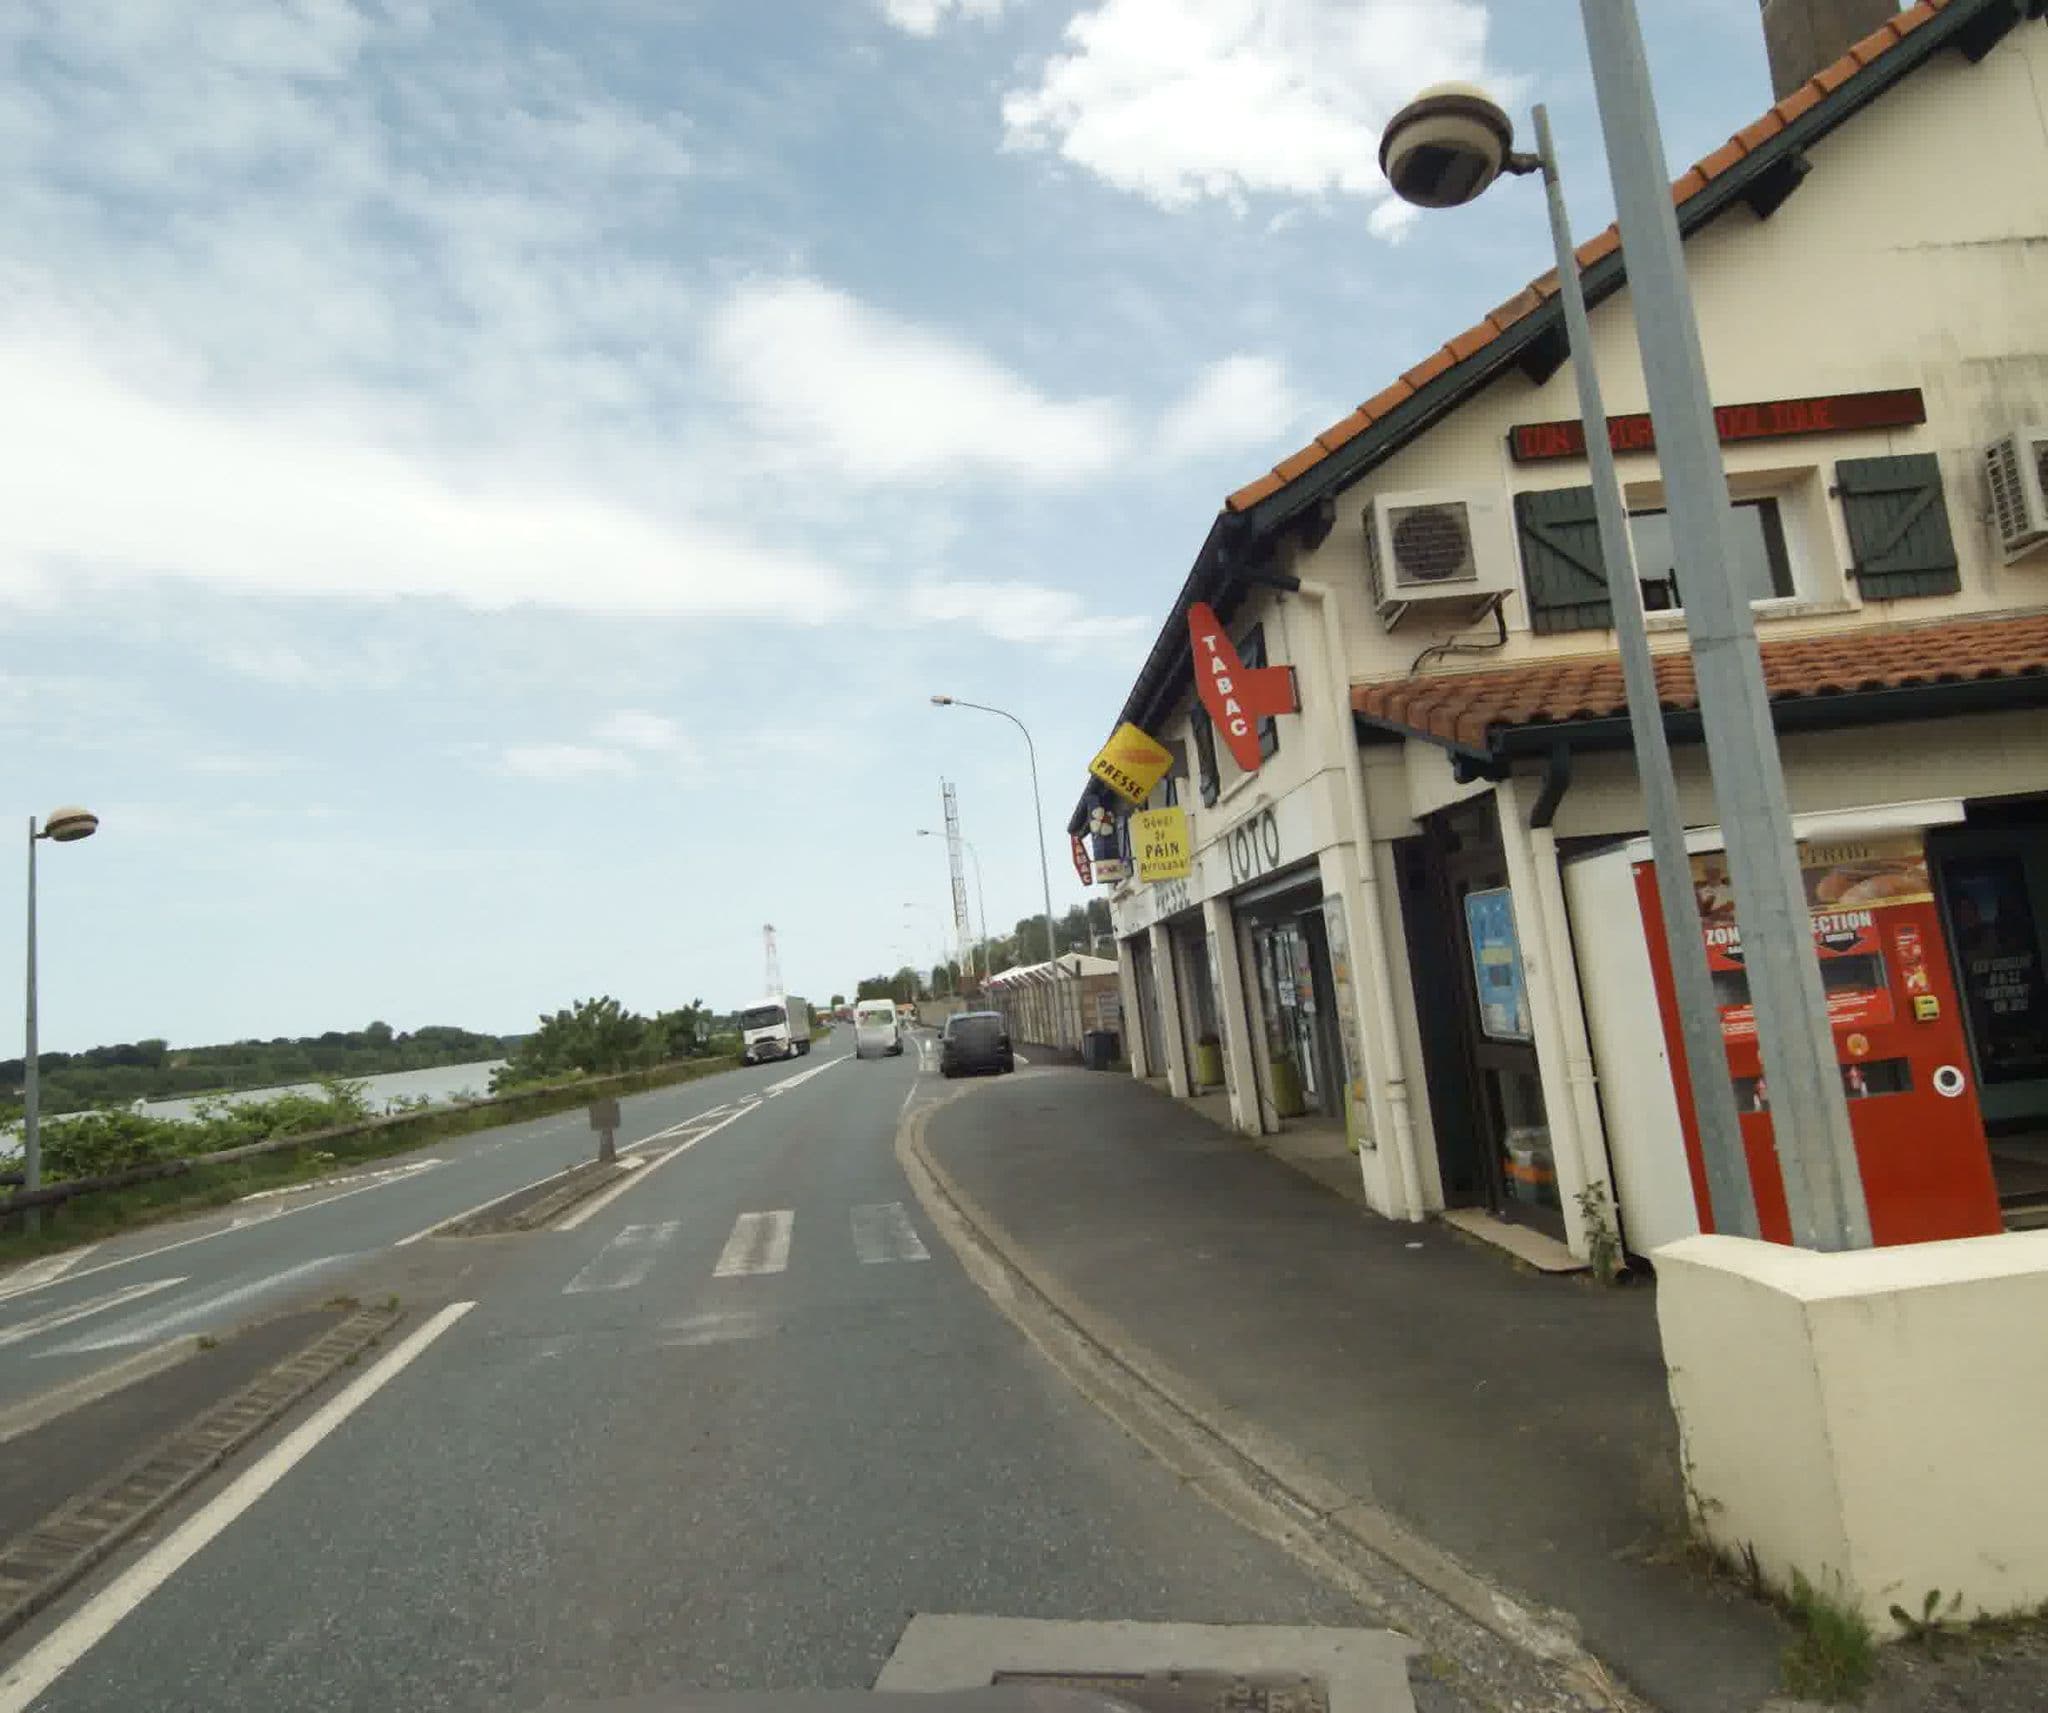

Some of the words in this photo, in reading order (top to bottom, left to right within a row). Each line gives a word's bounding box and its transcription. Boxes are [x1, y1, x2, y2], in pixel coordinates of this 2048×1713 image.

[1202, 635, 1248, 736] TABAC
[1097, 760, 1144, 800] PRESSE
[1145, 843, 1179, 858] PAIN
[1227, 808, 1280, 888] LOTO
[1706, 926, 1742, 946] ZON
[1812, 910, 1873, 934] ECTION
